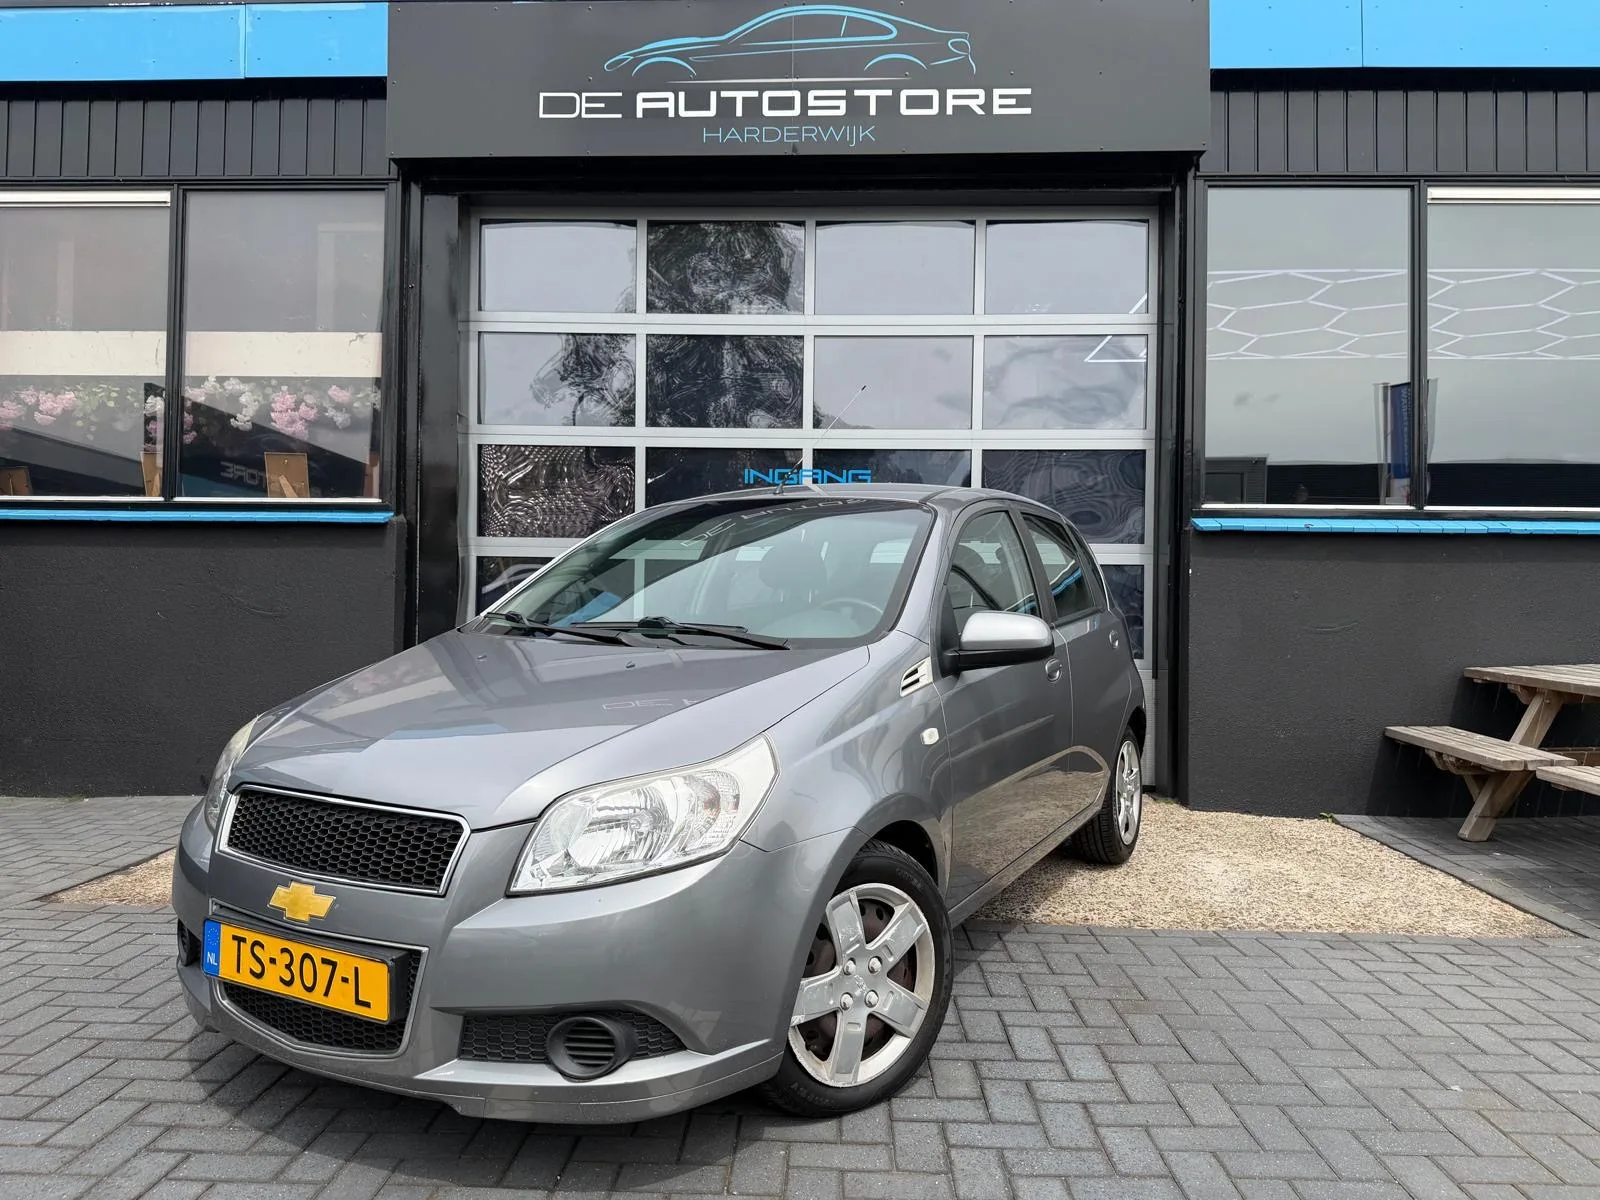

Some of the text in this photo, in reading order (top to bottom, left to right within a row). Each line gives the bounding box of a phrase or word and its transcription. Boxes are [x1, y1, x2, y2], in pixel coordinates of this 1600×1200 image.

[539, 88, 1032, 118] DE AUTOSTORE
[703, 125, 876, 147] HARDERWIJK
[744, 469, 872, 484] INGANG
[206, 951, 218, 966] NL
[231, 934, 372, 1008] TS-307-L
